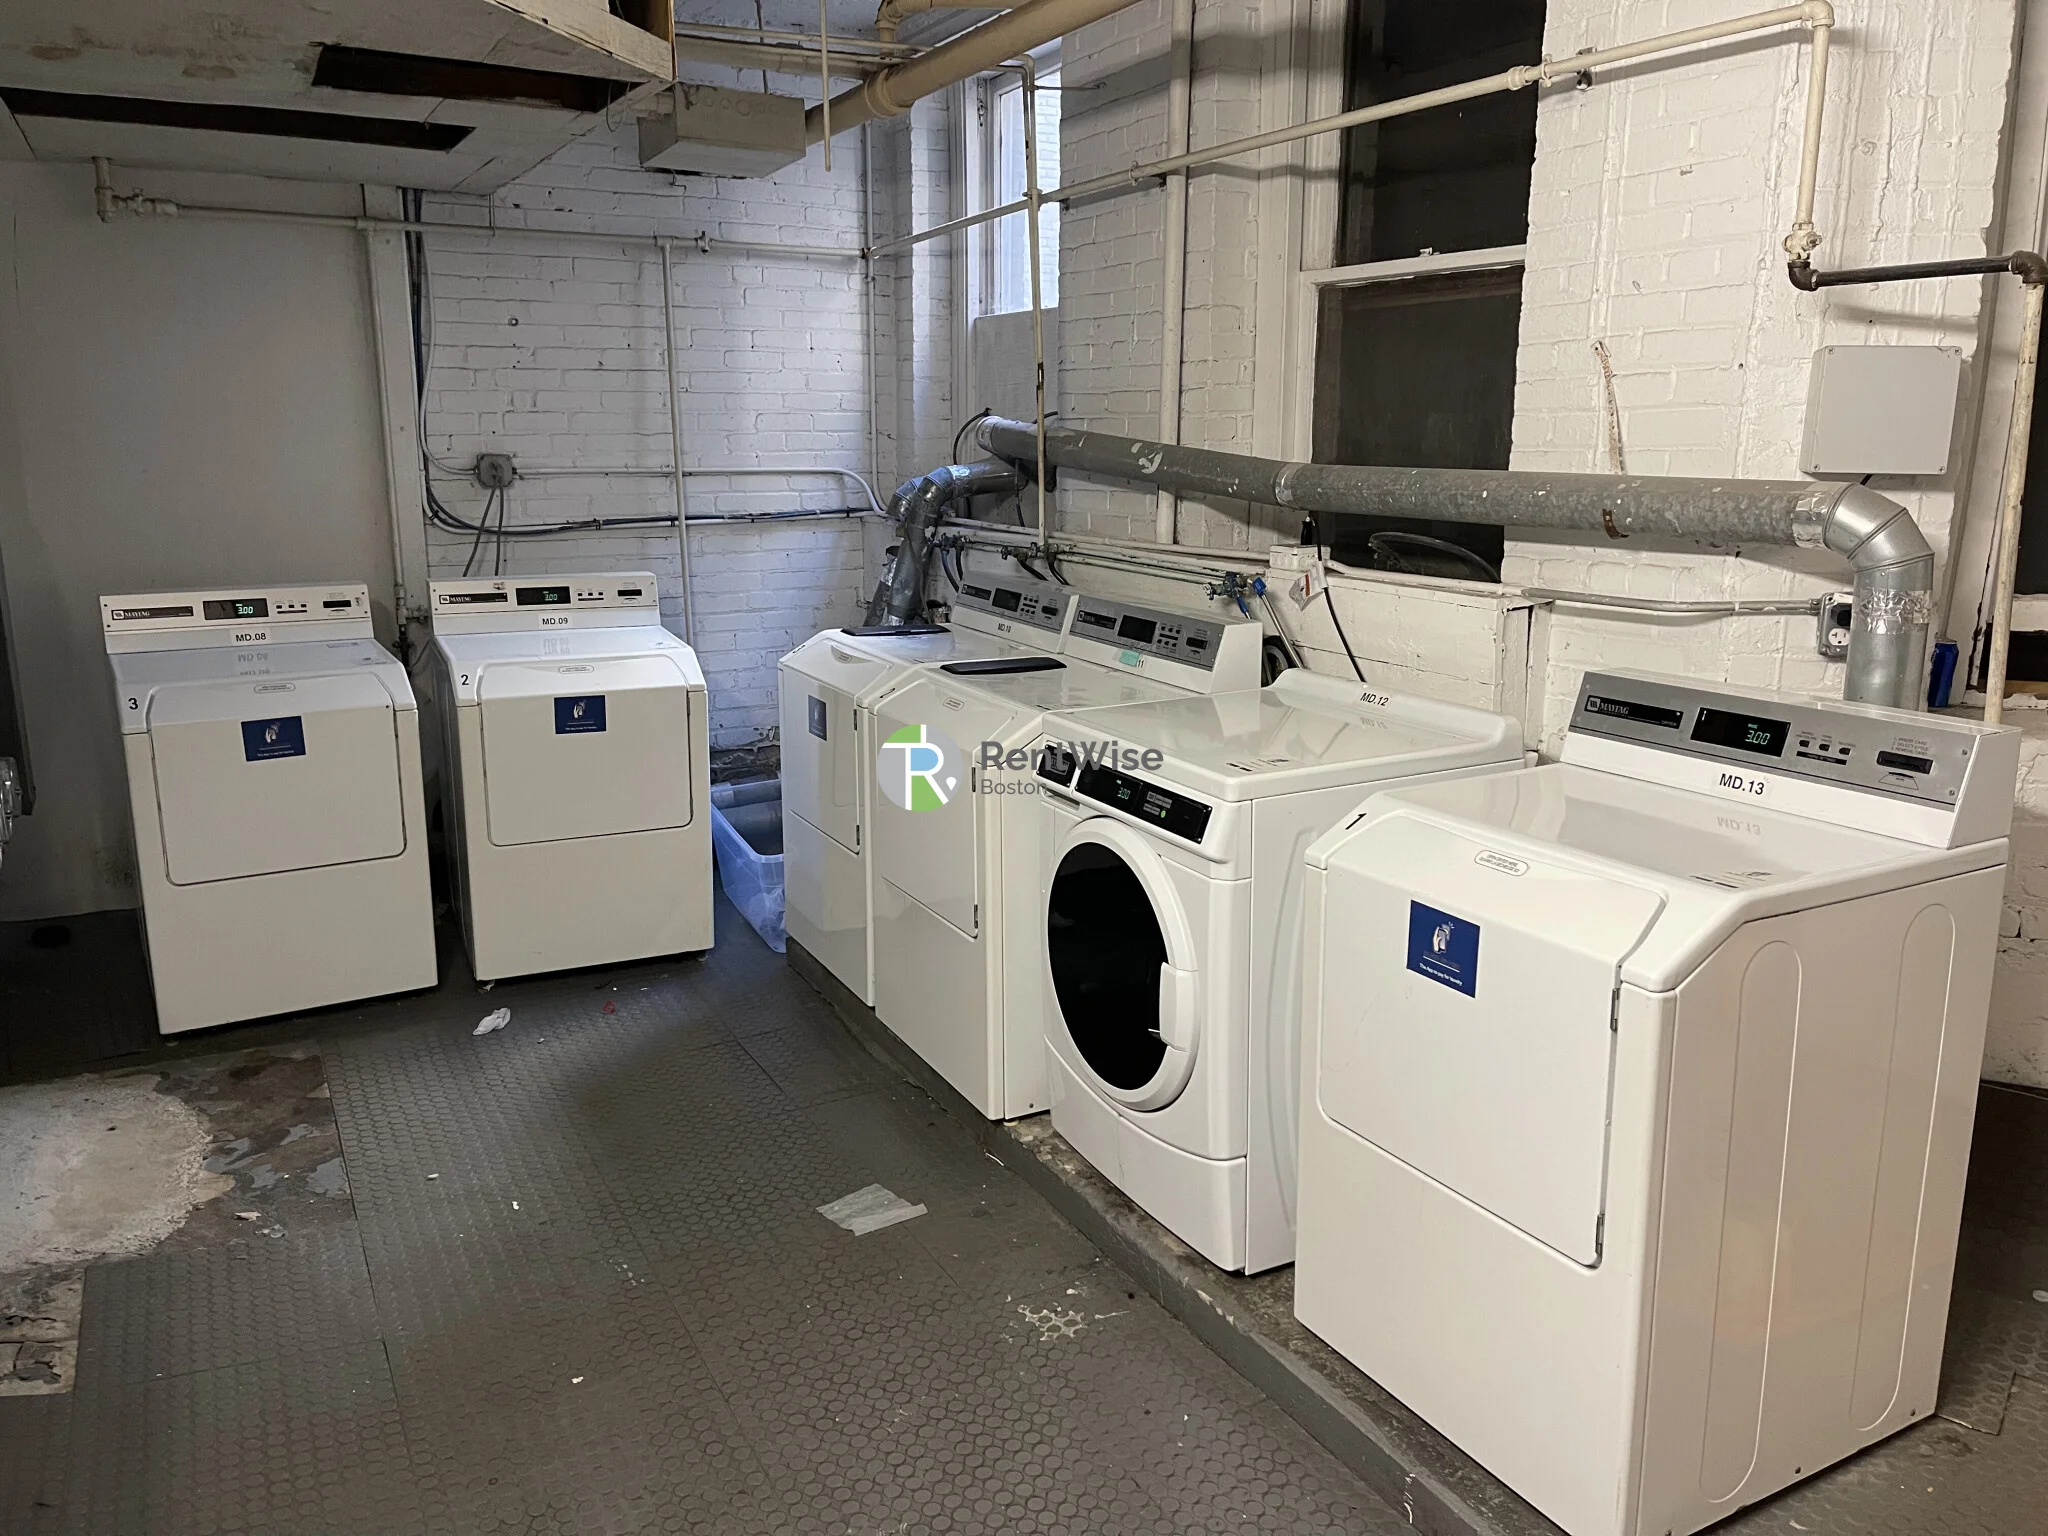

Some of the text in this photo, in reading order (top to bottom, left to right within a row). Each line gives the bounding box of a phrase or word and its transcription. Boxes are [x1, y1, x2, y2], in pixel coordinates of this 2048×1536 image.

[237, 605, 254, 614] 3.00
[542, 617, 569, 625] MD.09
[235, 632, 267, 642] MD.08
[460, 674, 470, 686] 2
[128, 697, 139, 710] 3
[1360, 692, 1389, 706] MD.12
[1599, 702, 1630, 715] MAYTAG
[1744, 729, 1771, 745] 3.00
[1719, 773, 1765, 795] MD.13
[1345, 812, 1367, 831] 1
